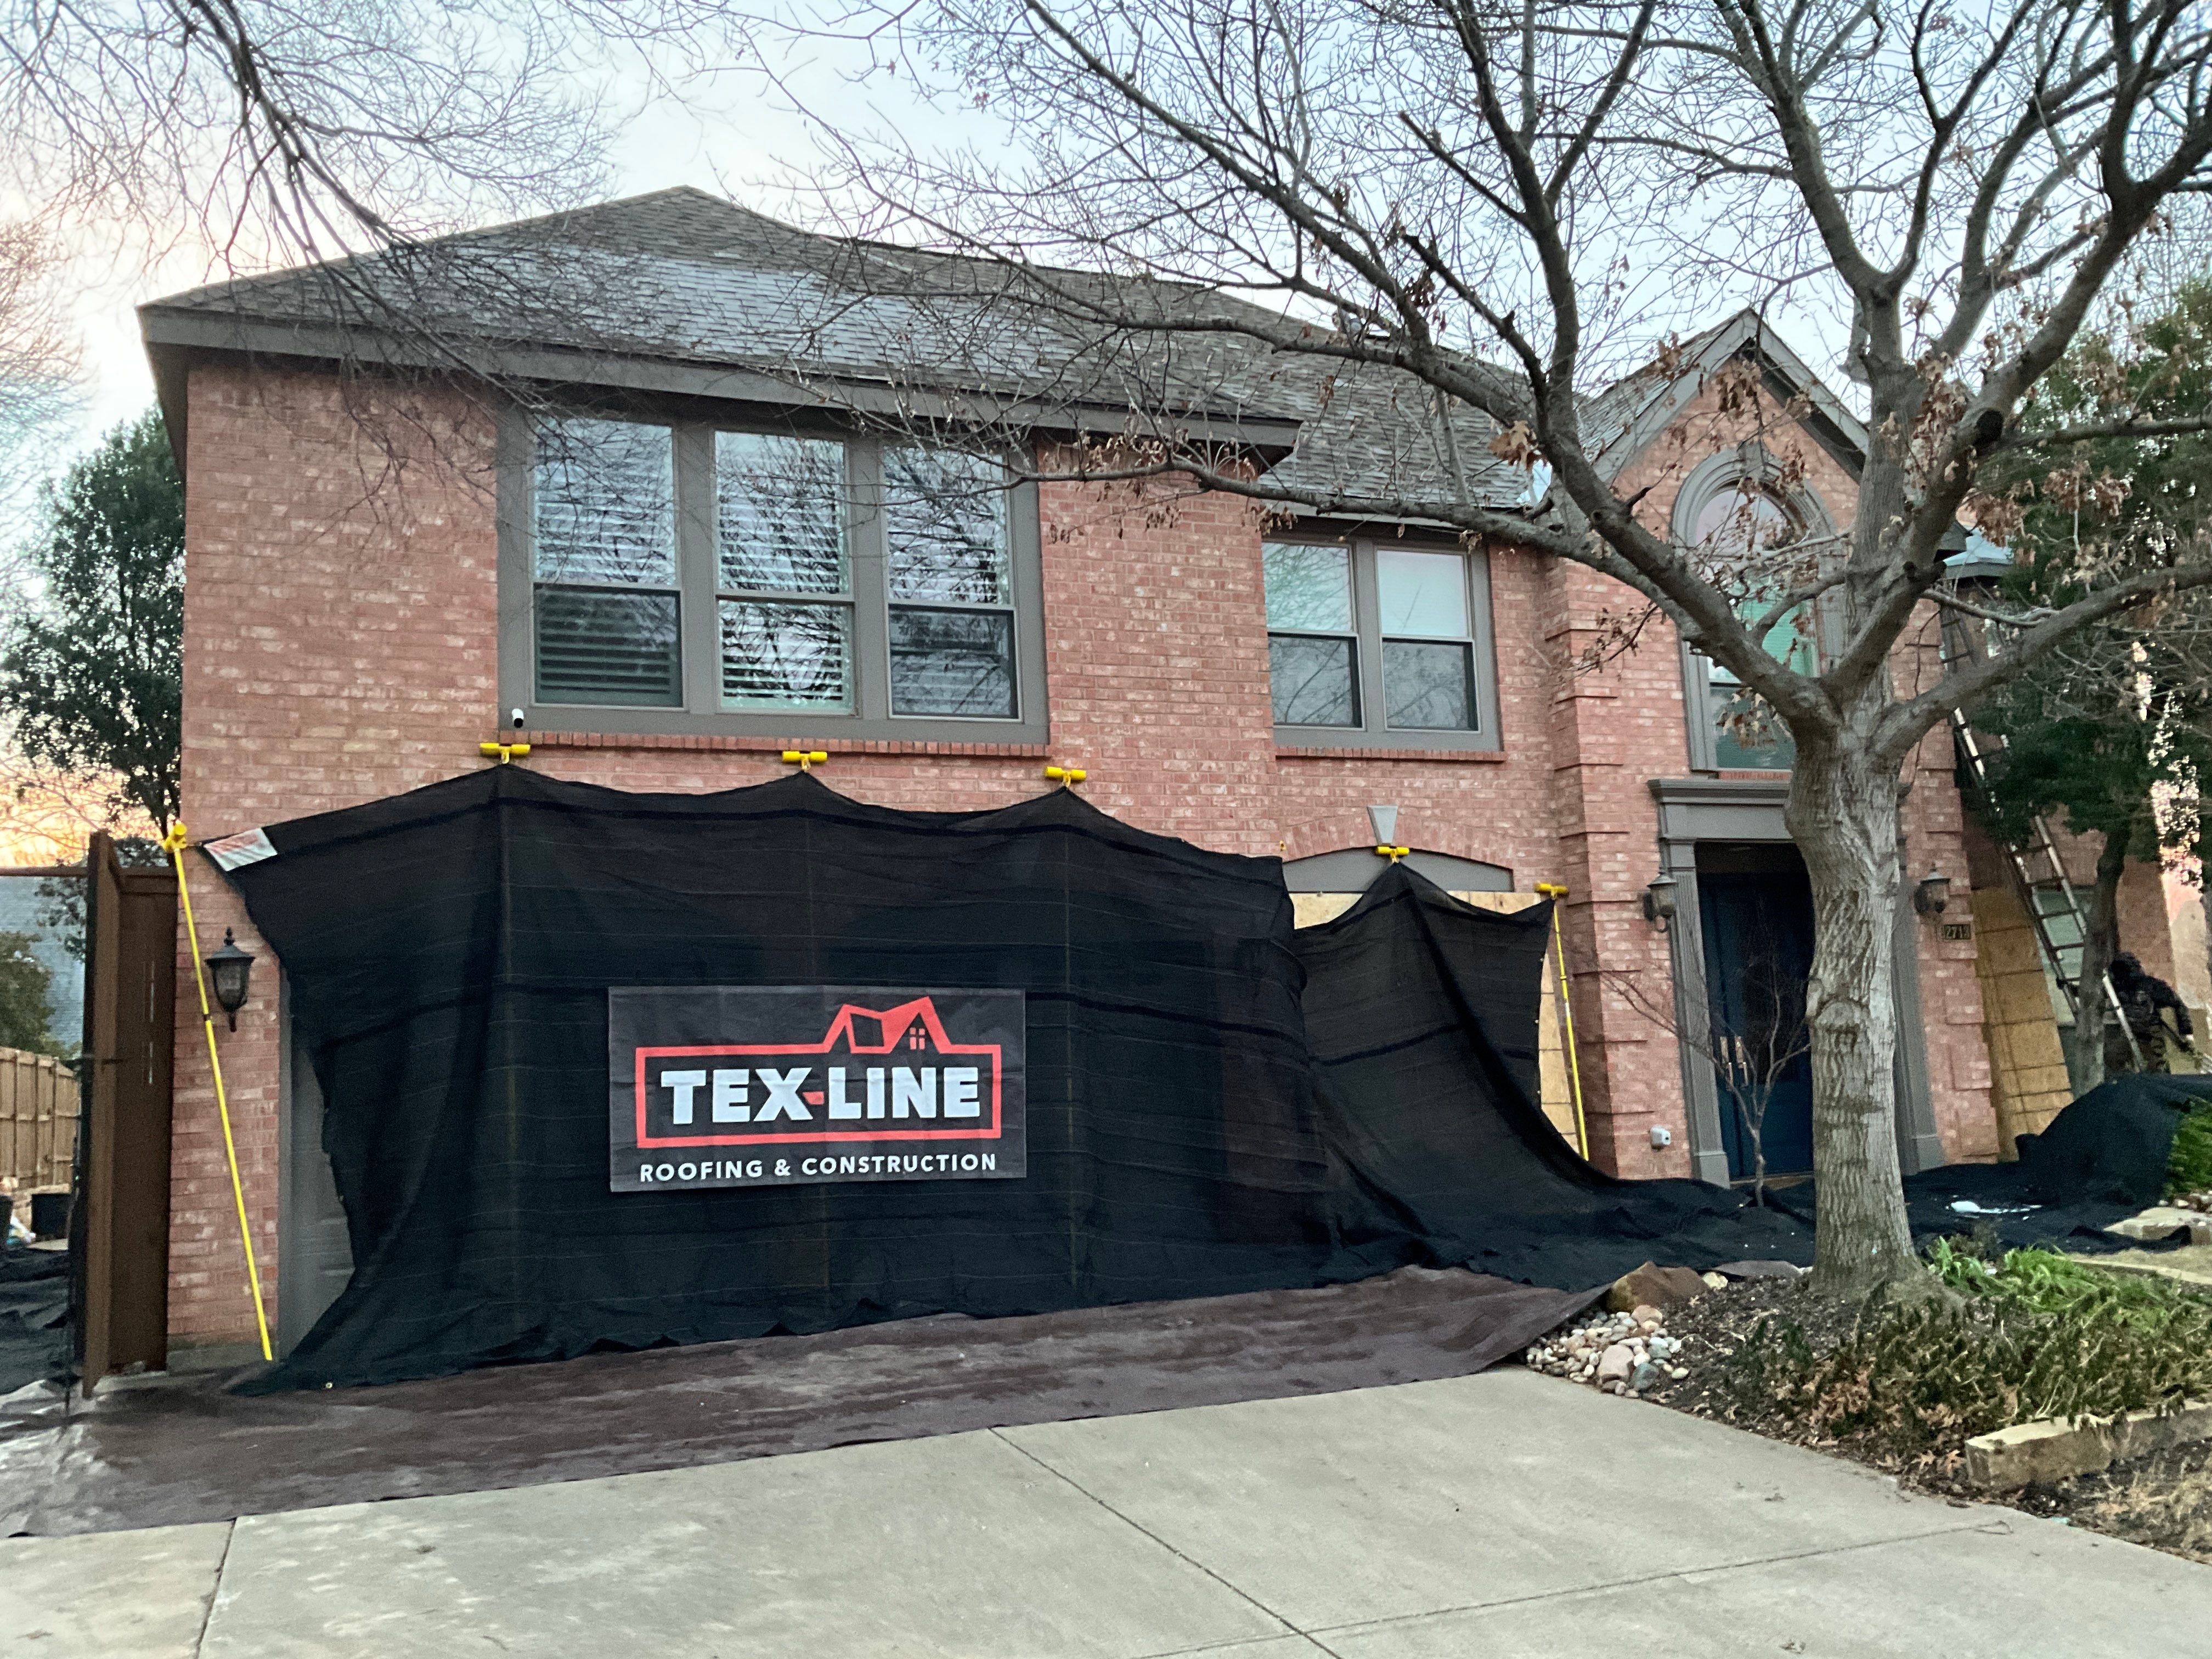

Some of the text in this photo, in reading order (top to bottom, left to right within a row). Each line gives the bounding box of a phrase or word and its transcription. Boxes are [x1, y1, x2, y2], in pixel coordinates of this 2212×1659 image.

[661, 1066, 980, 1125] TEX-LINE
[640, 1153, 995, 1182] ROOFING & CONSTRUCTION
